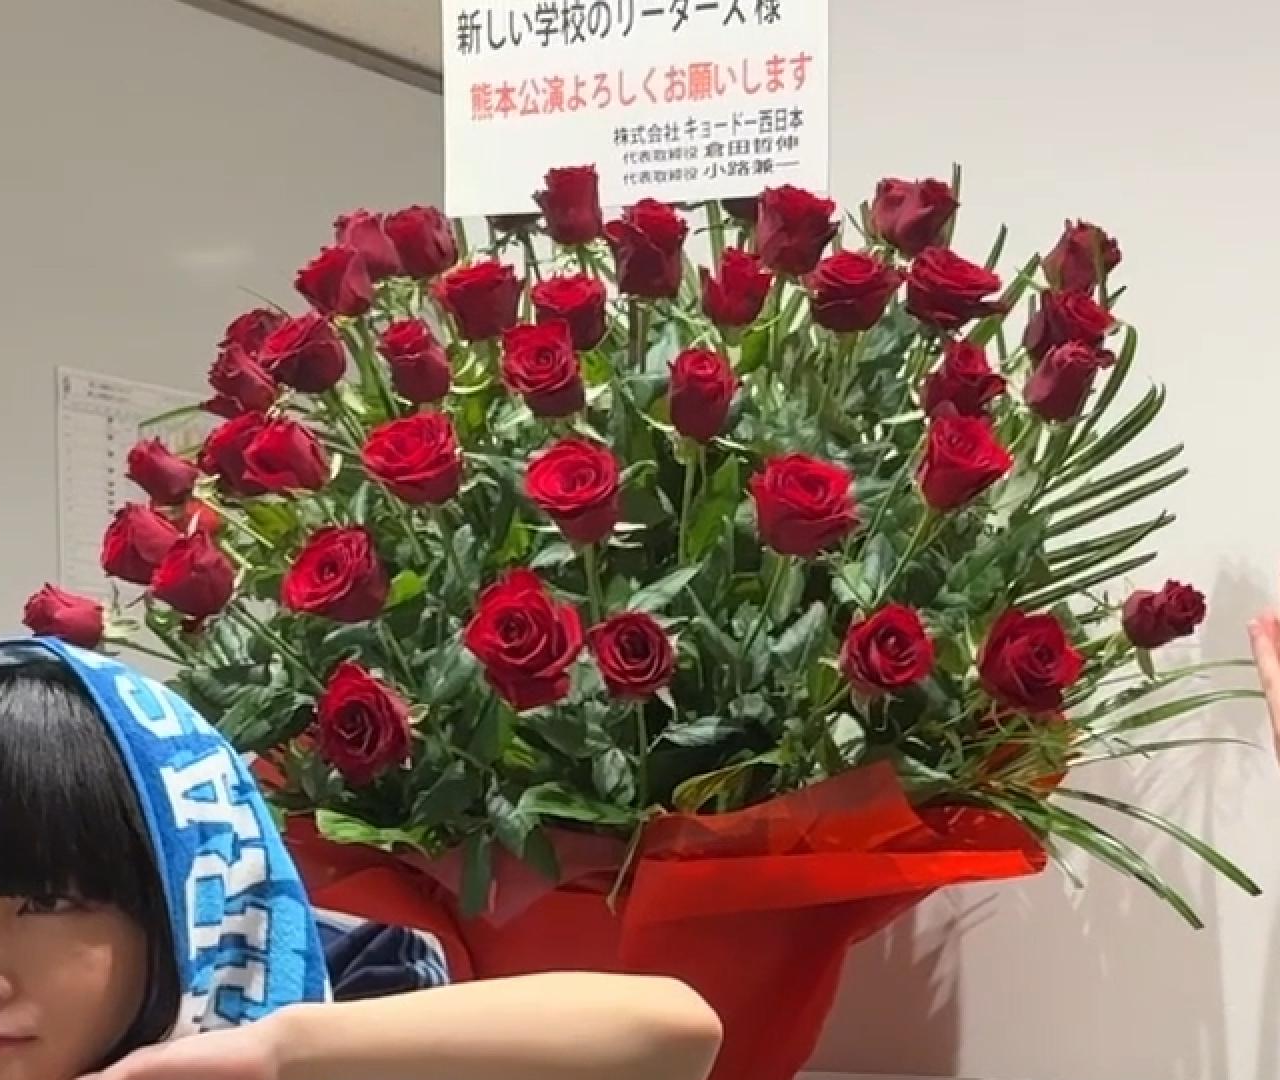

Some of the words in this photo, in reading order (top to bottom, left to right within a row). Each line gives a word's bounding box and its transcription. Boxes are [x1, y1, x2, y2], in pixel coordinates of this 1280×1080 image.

[470, 51, 813, 121] 熊本公演よろしくお願いします
